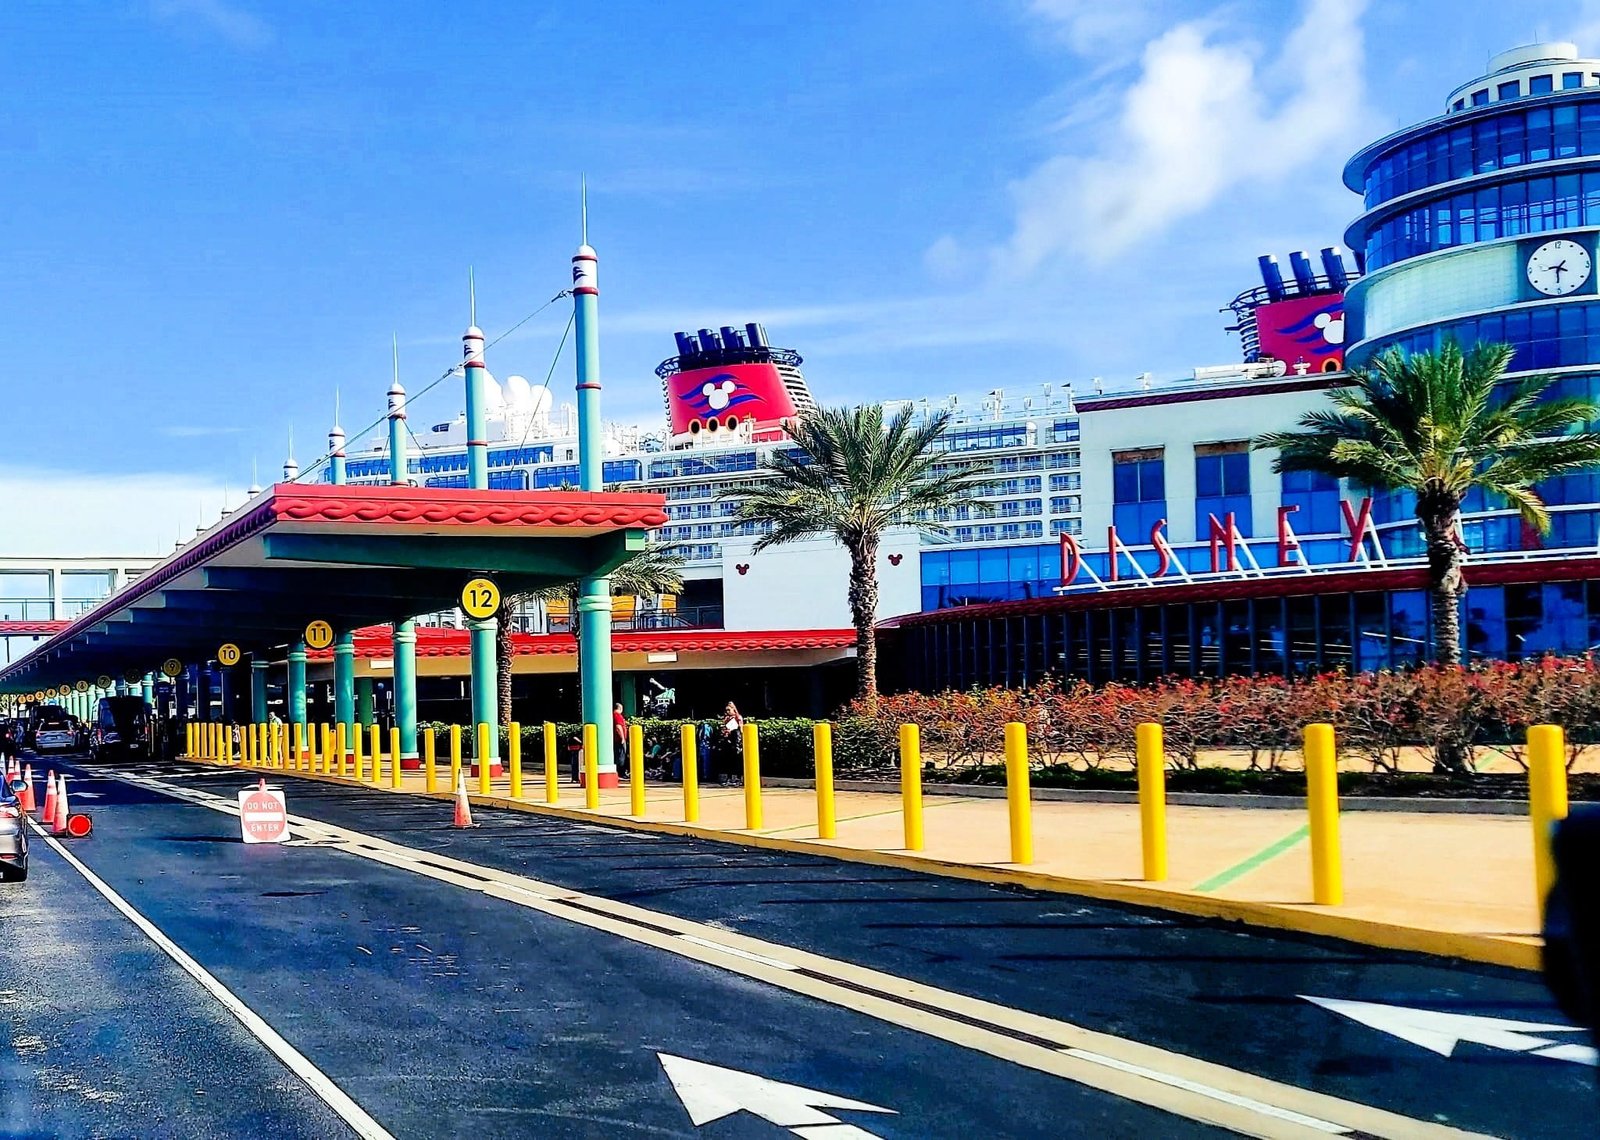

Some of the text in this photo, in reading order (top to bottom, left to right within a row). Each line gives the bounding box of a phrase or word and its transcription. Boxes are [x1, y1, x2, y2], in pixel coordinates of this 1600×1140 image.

[1554, 241, 1562, 249] 12
[1060, 497, 1373, 586] DISNEY
[469, 589, 493, 608] 12
[311, 627, 327, 641] 11
[222, 649, 236, 660] 10
[169, 662, 176, 672] 9
[247, 801, 278, 810] DO NOT
[251, 823, 279, 832] ENTER
